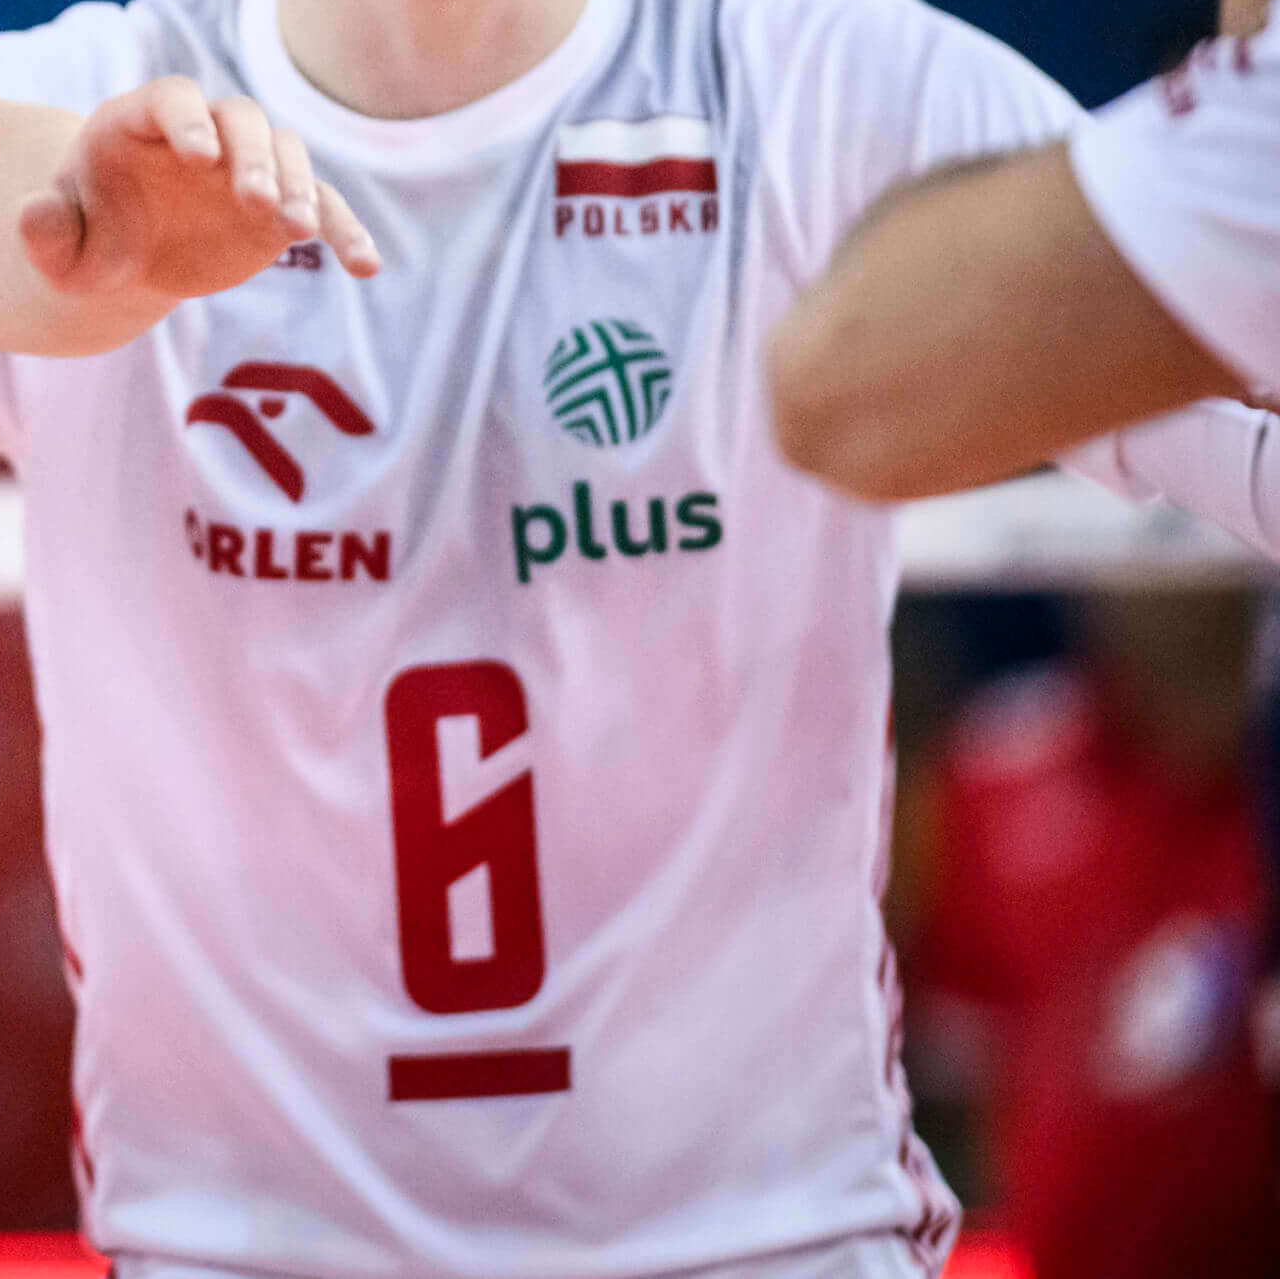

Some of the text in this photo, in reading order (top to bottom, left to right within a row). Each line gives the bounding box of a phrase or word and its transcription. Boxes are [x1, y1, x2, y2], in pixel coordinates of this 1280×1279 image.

[554, 200, 720, 238] POLSKA
[511, 481, 723, 584] plus
[383, 658, 547, 1016] 6
